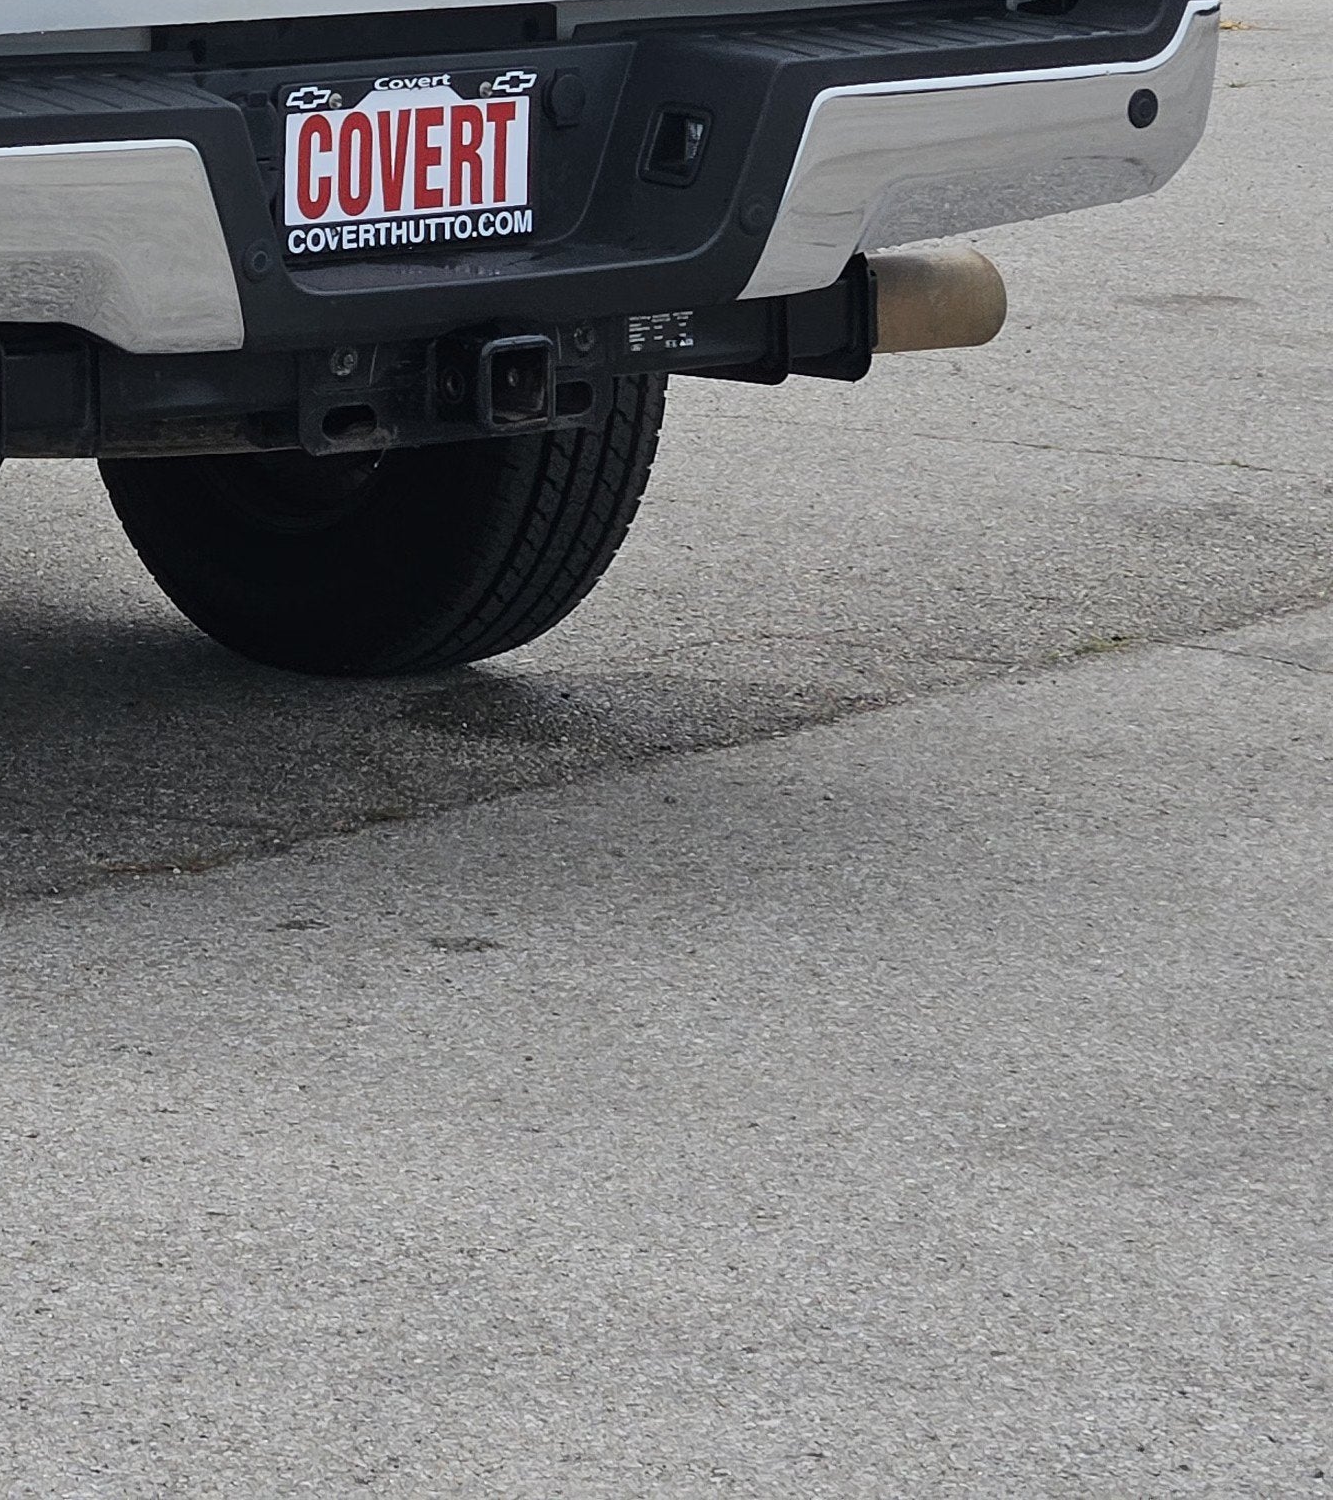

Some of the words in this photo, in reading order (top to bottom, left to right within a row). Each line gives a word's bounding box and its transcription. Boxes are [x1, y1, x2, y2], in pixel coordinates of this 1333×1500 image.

[373, 73, 452, 91] Covert
[296, 100, 517, 220] COVERT
[287, 209, 533, 255] COVERTHUTTO.COM
